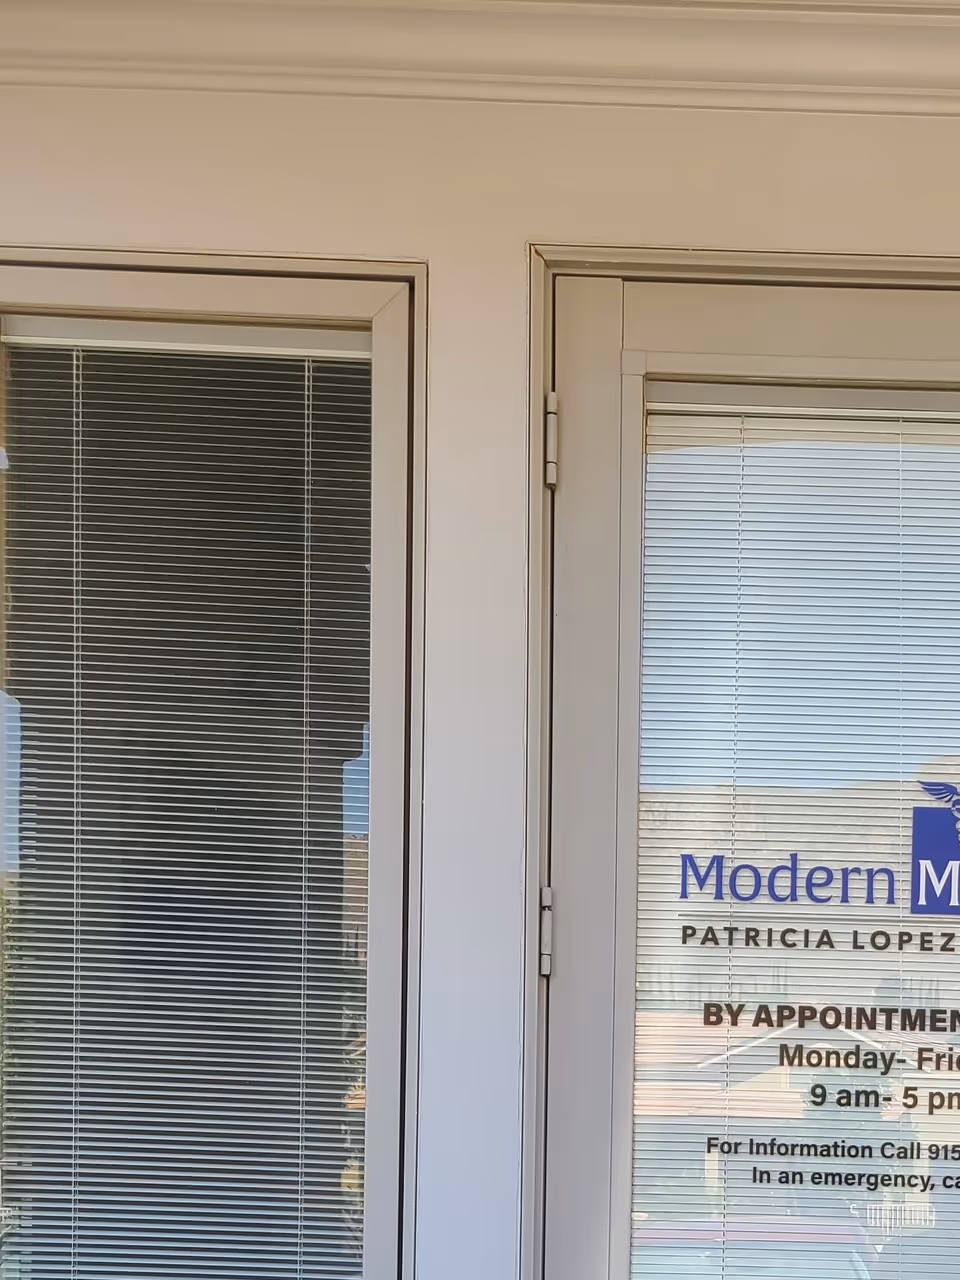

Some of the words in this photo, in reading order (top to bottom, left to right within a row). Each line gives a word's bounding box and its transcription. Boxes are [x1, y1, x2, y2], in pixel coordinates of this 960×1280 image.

[679, 853, 896, 905] Modern
[681, 924, 836, 949] PATRICIA
[852, 930, 956, 953] LOPEZ
[702, 1002, 745, 1028] BY
[778, 1043, 907, 1076] Monday-
[810, 1083, 828, 1107] 9
[835, 1089, 892, 1109] am-
[902, 1086, 919, 1109] 5
[706, 1137, 741, 1155] For
[749, 1138, 873, 1159] Information
[880, 1141, 920, 1160] Call
[752, 1167, 770, 1184] In
[777, 1171, 803, 1185] an
[810, 1172, 935, 1192] emergency,
